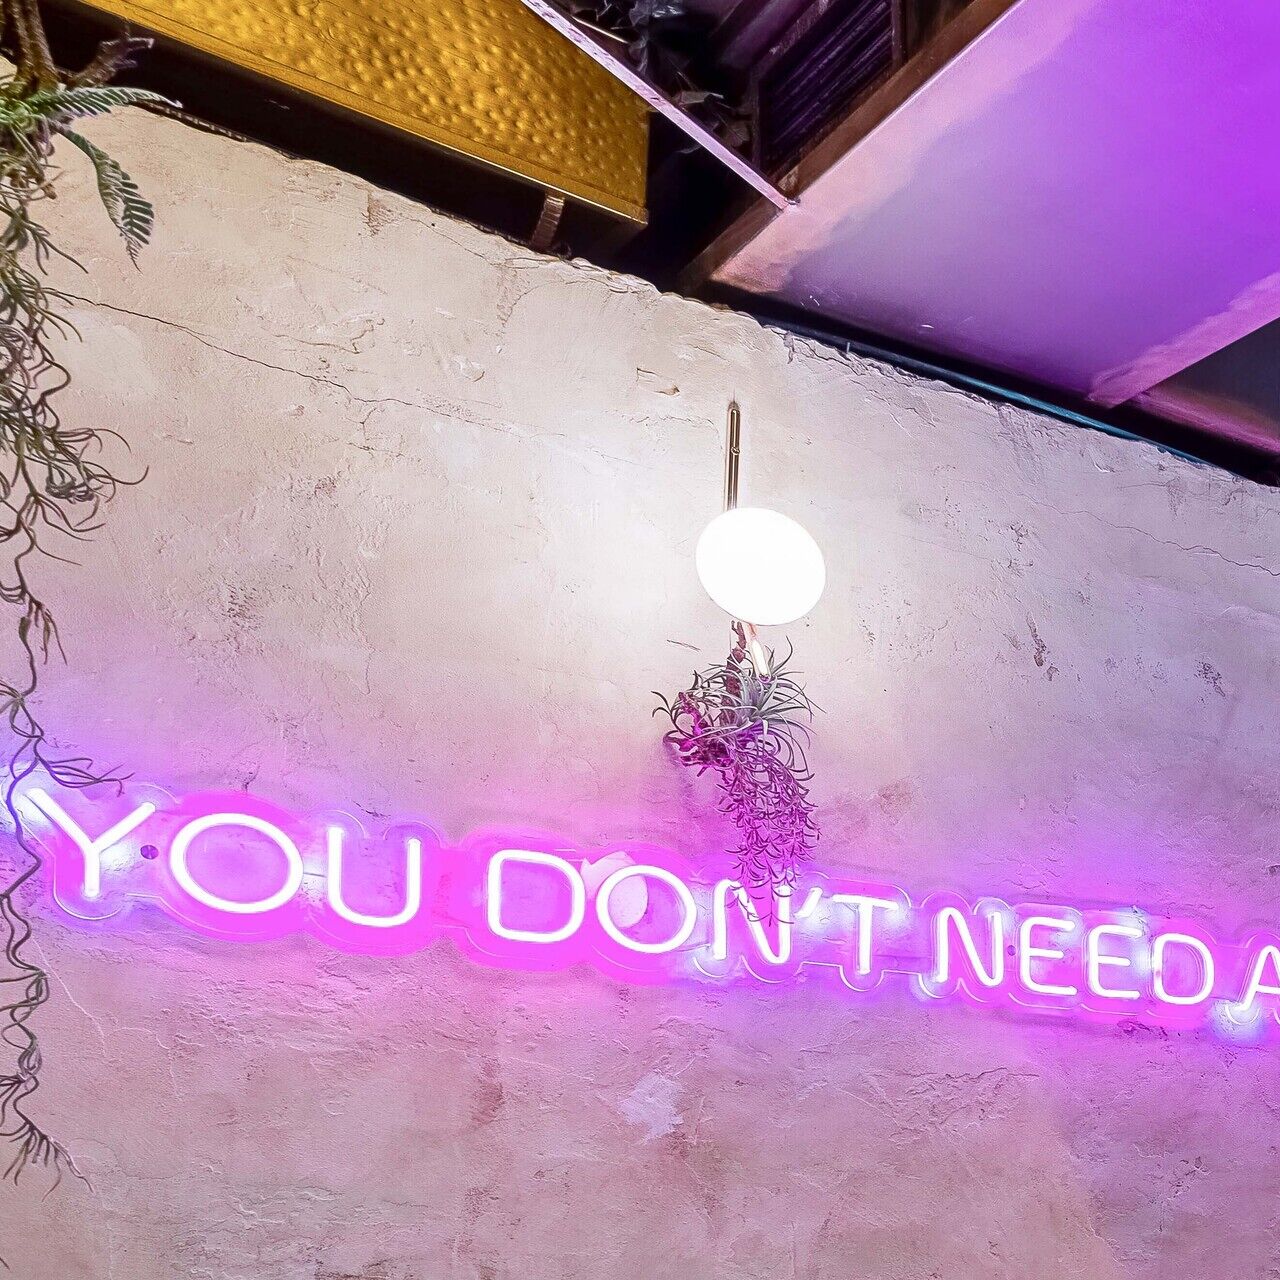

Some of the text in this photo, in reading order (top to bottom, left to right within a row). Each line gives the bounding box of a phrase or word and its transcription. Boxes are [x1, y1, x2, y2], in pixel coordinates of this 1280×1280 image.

[26, 787, 422, 928] YOU
[486, 848, 896, 975] DON'T
[936, 905, 1215, 1005] NEED
